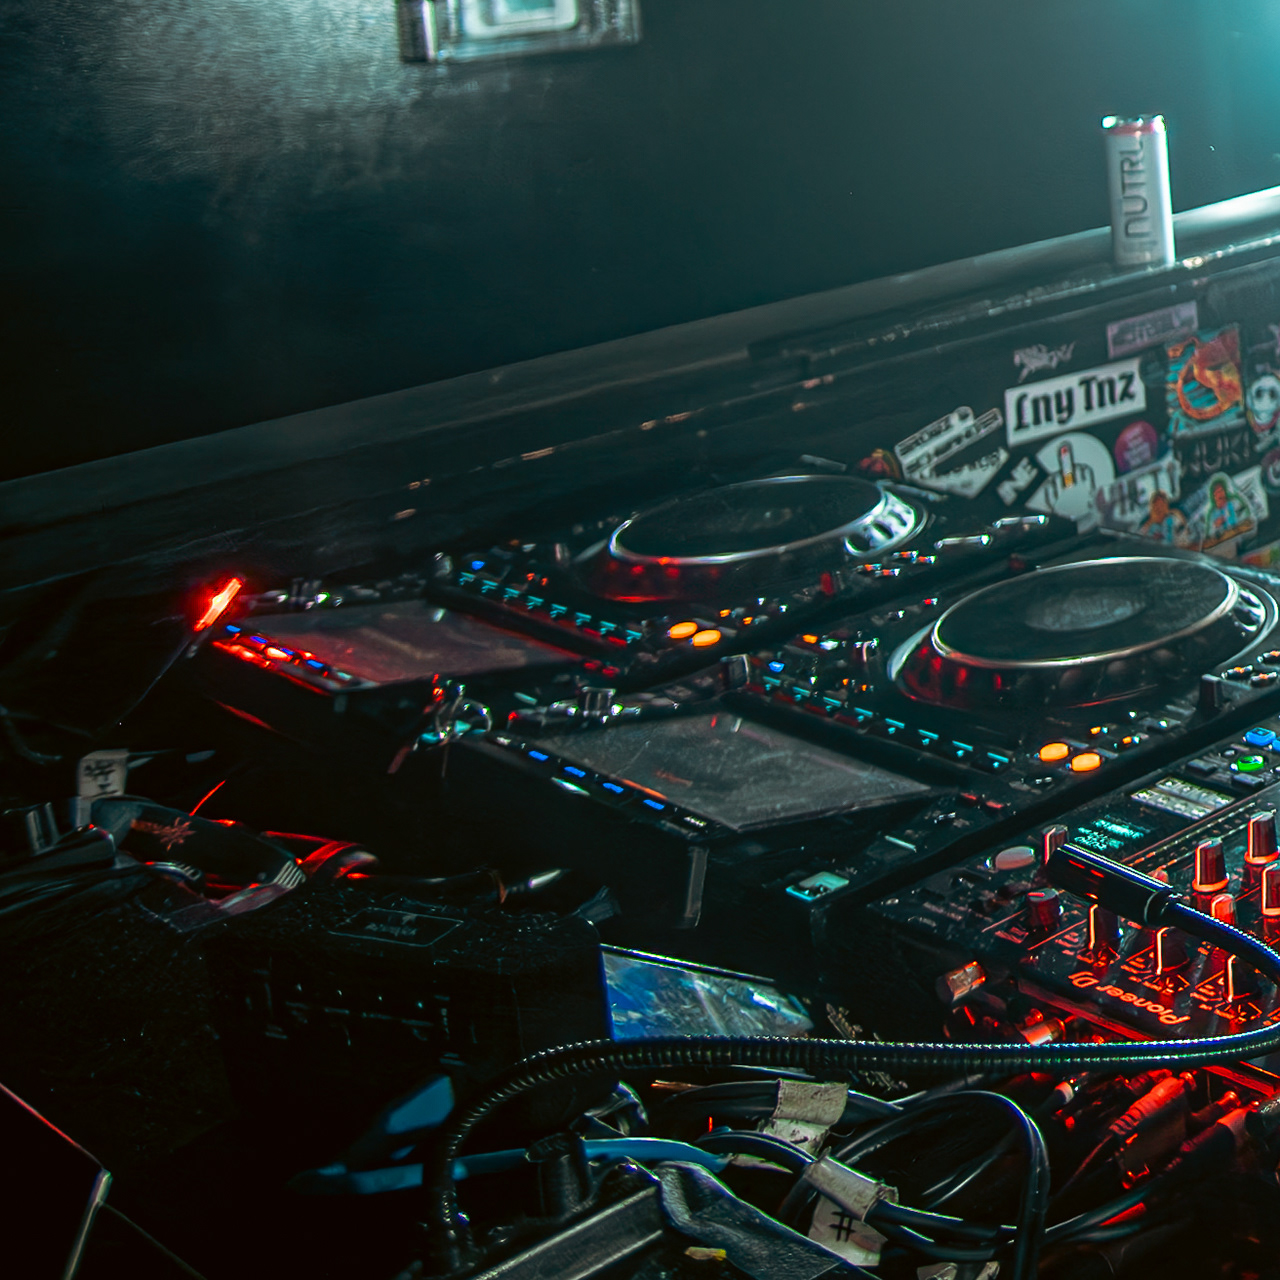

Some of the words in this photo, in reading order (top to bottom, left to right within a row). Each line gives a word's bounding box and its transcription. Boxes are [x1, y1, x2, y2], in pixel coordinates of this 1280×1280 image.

[1119, 141, 1154, 238] NUTRL
[1067, 971, 1099, 988] DJ
[1095, 983, 1190, 1025] Pioneer
